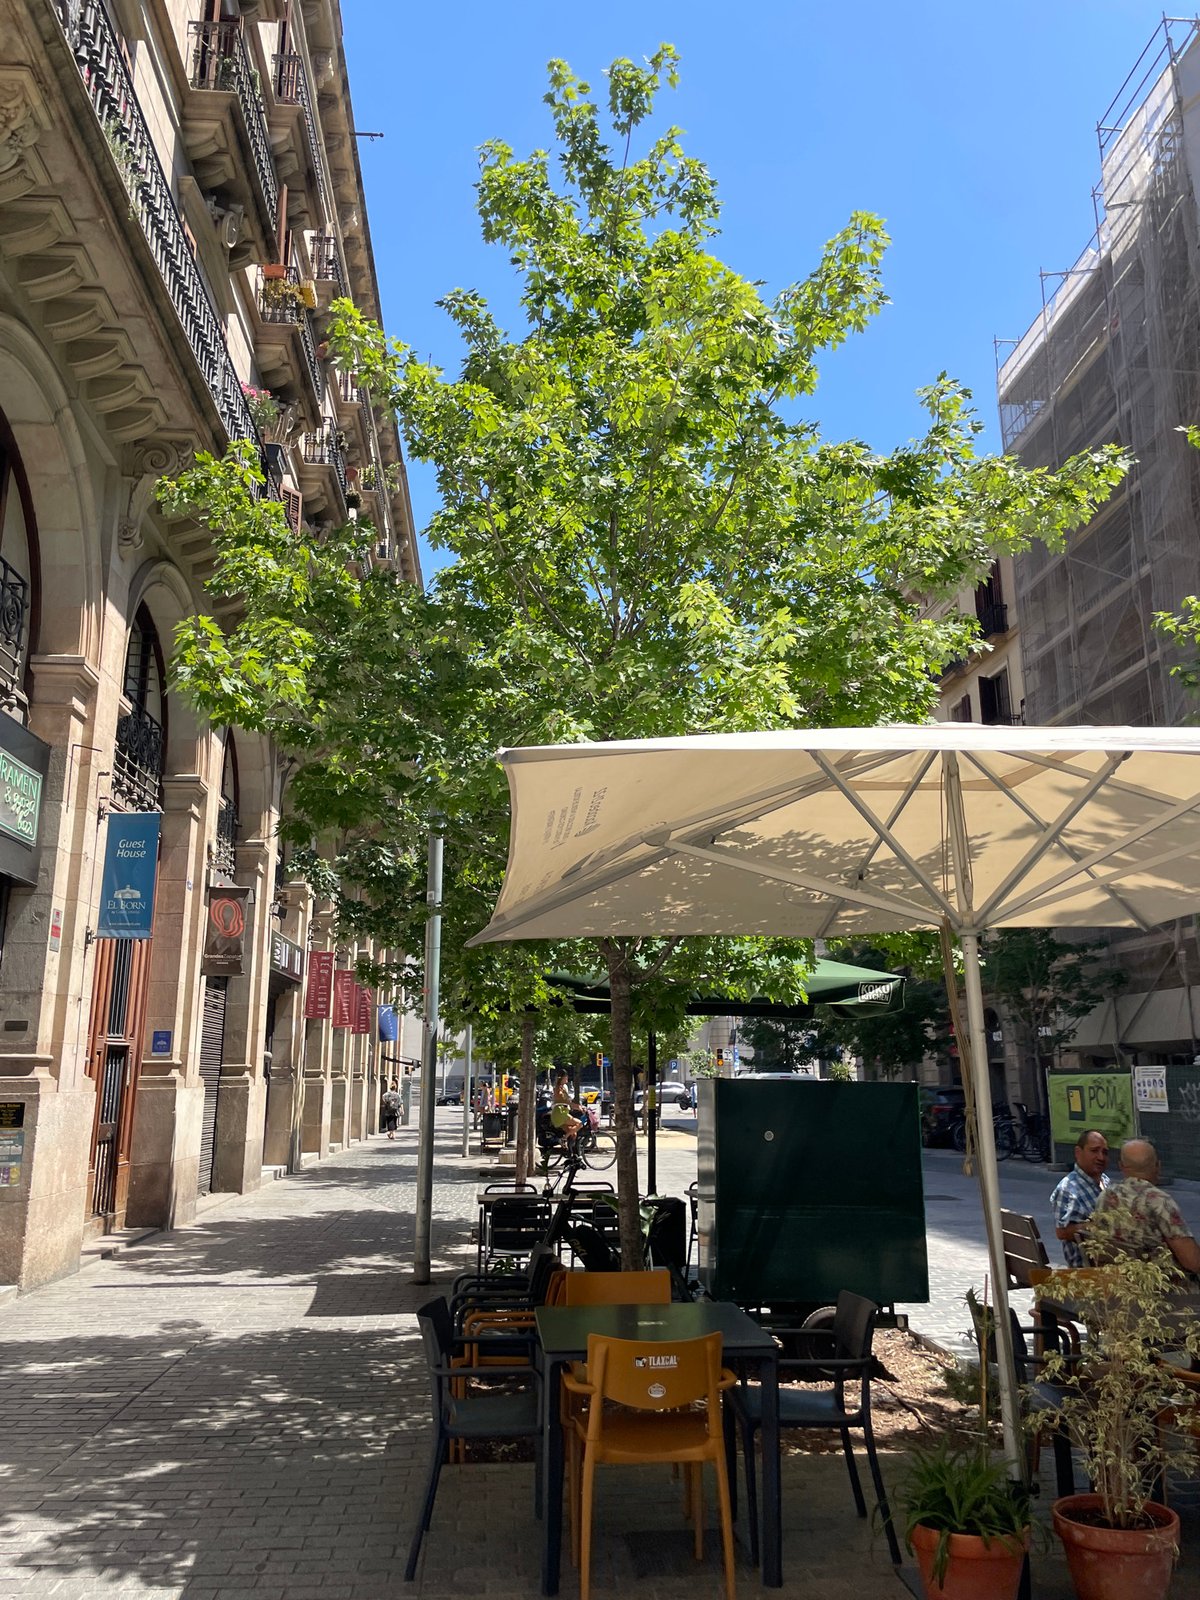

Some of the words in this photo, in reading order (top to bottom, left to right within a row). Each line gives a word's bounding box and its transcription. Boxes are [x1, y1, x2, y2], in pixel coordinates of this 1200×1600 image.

[0, 760, 38, 799] RAMEN
[118, 839, 146, 849] Guest
[116, 849, 146, 858] House
[861, 984, 890, 995] KOKU
[861, 993, 889, 1001] KITCHEN
[1088, 1086, 1117, 1110] PCM
